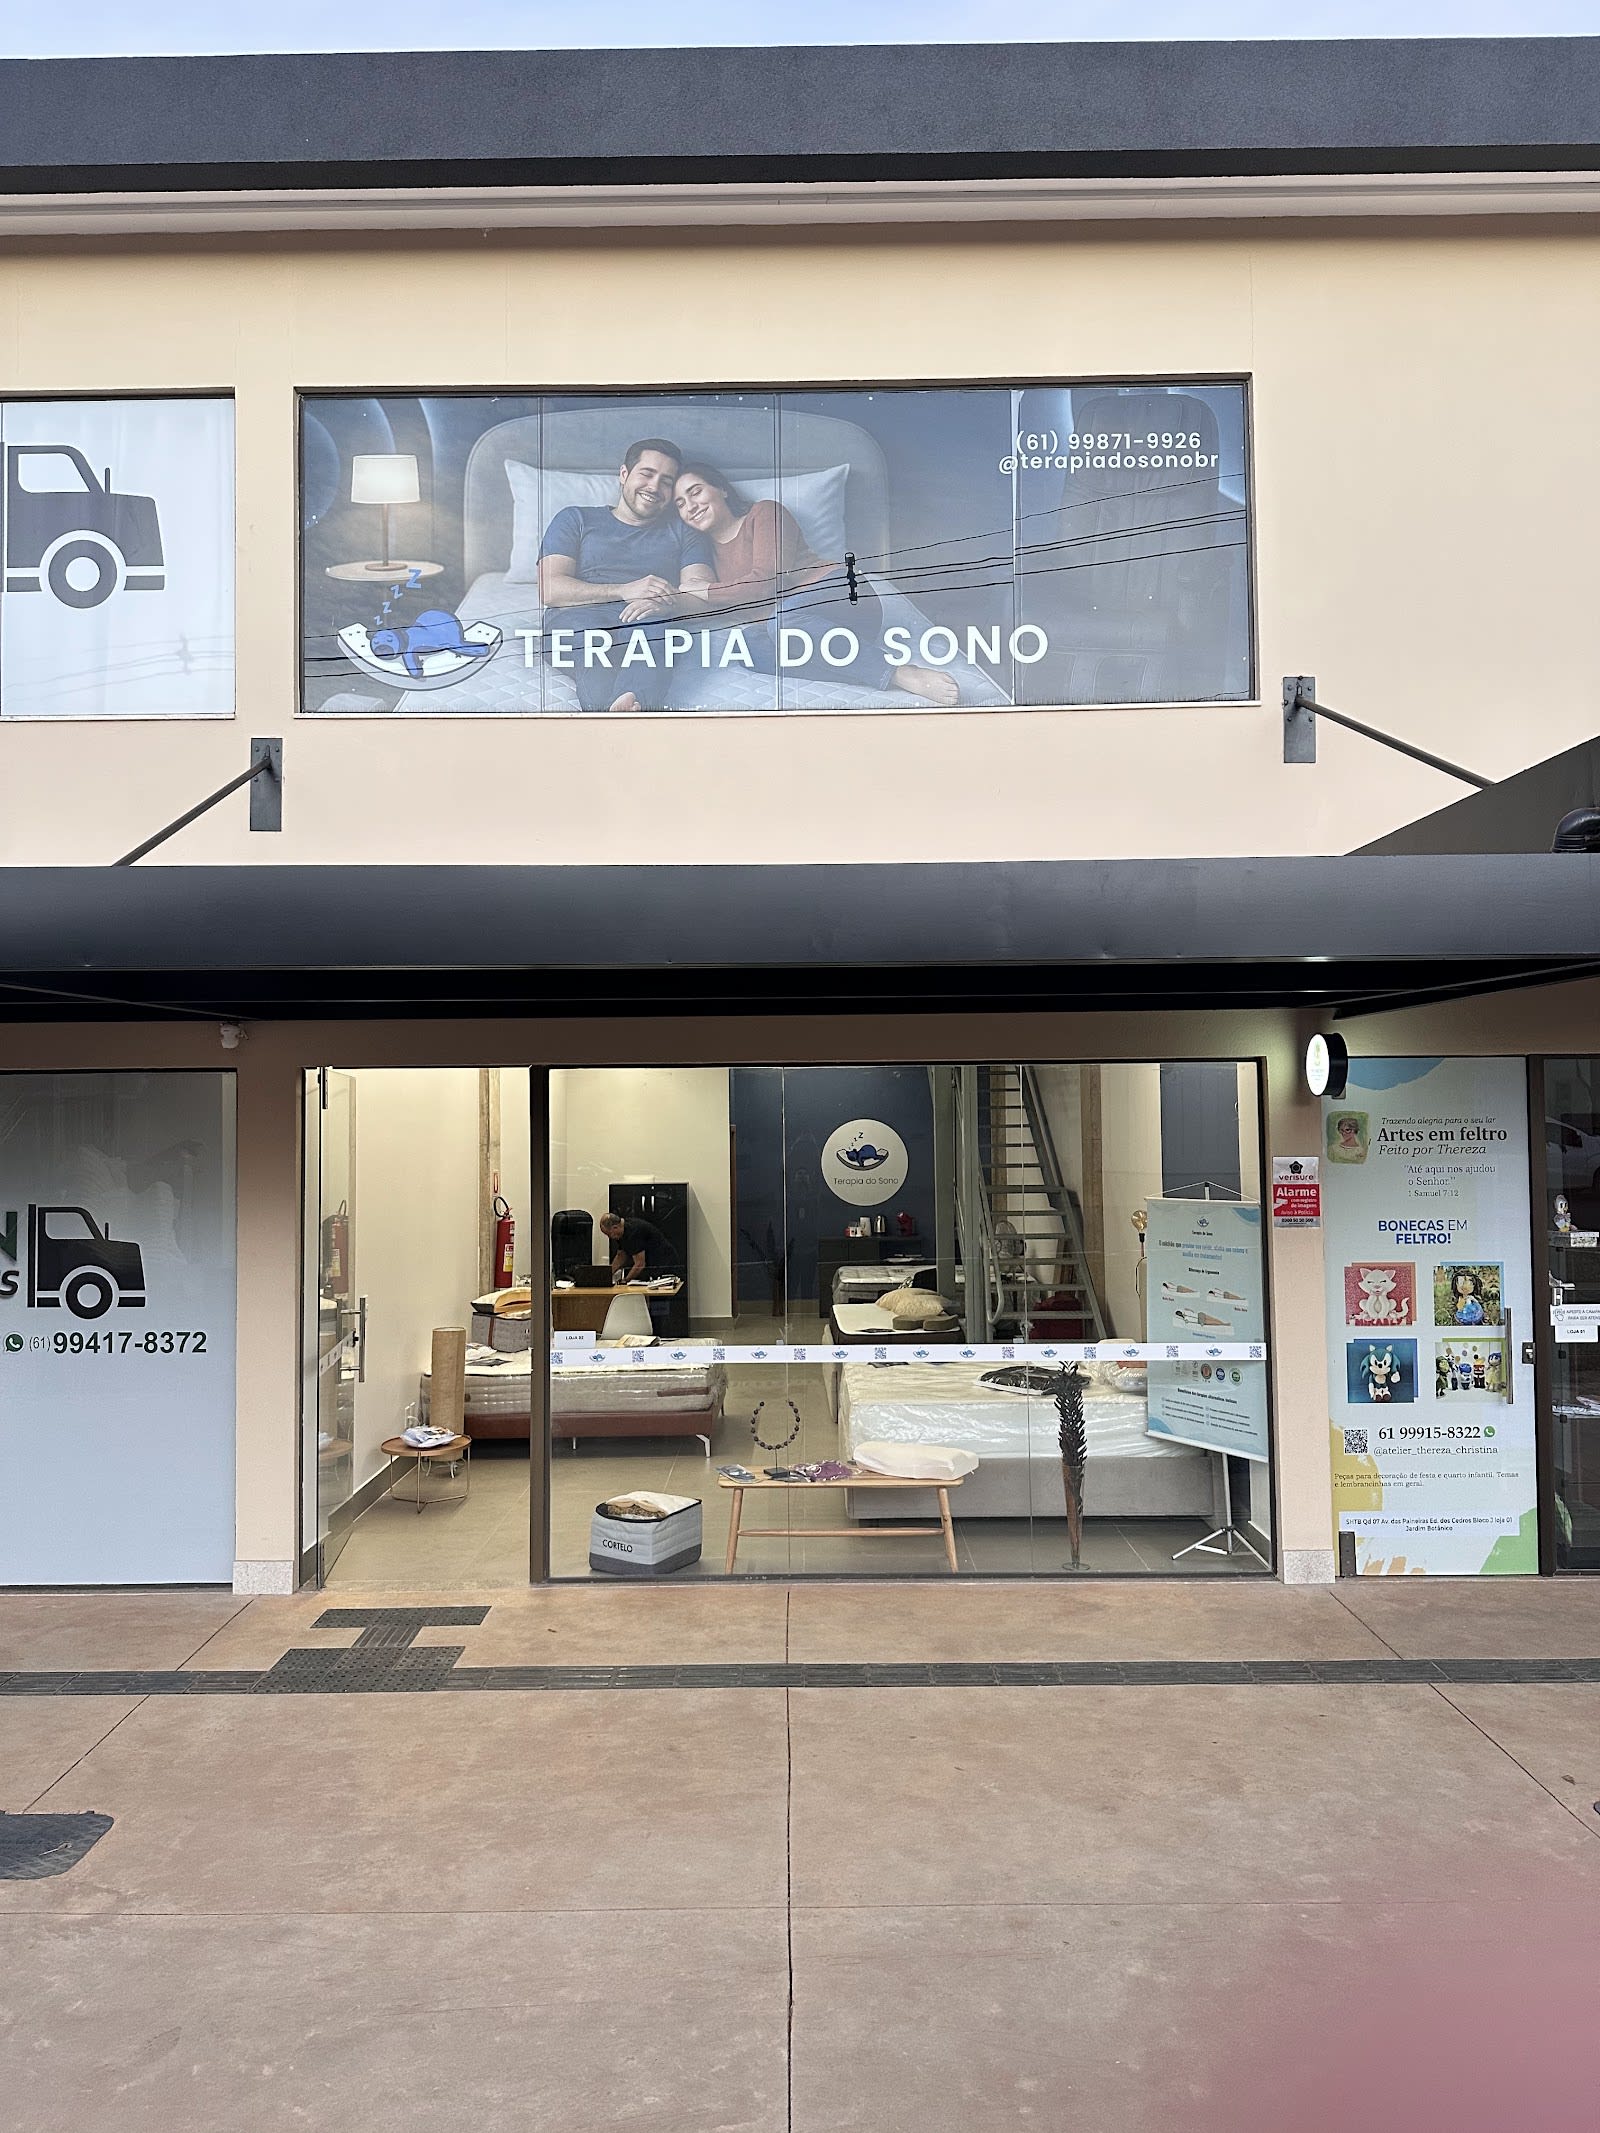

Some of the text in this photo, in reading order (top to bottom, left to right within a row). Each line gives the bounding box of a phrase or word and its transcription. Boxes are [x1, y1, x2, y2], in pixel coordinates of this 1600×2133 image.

[1016, 430, 1201, 454] (61) 99871-9926
[999, 451, 1219, 475] @terapiadosonobr
[514, 624, 1049, 668] TERAPIA DO SONO
[1381, 1117, 1416, 1125] Trazendo
[1417, 1117, 1443, 1126] alegria
[1444, 1117, 1462, 1126] para
[1485, 1116, 1497, 1124] lar
[1377, 1126, 1508, 1142] Artes em feltro
[1379, 1143, 1487, 1157] Feito por Thereza
[1425, 1166, 1445, 1176] aqui
[1447, 1166, 1463, 1174] nos
[1465, 1164, 1496, 1175] ajudou
[834, 1177, 899, 1187] Terapia do Sono
[1276, 1186, 1317, 1197] Alarme
[1414, 1189, 1441, 1197] Samuel
[1378, 1219, 1468, 1232] BONECAS EM
[1396, 1233, 1452, 1245] FELTRO!
[29, 1331, 207, 1354] (61) 99417-8372
[1379, 1426, 1481, 1440] 61 99915-8322
[1373, 1446, 1498, 1457] @atelier_thereza_christina
[1334, 1473, 1354, 1481] Peças
[1373, 1472, 1408, 1480] decoração
[1443, 1472, 1467, 1480] quarto
[1362, 1518, 1372, 1526] Qd
[602, 1539, 633, 1553] CORTELO
